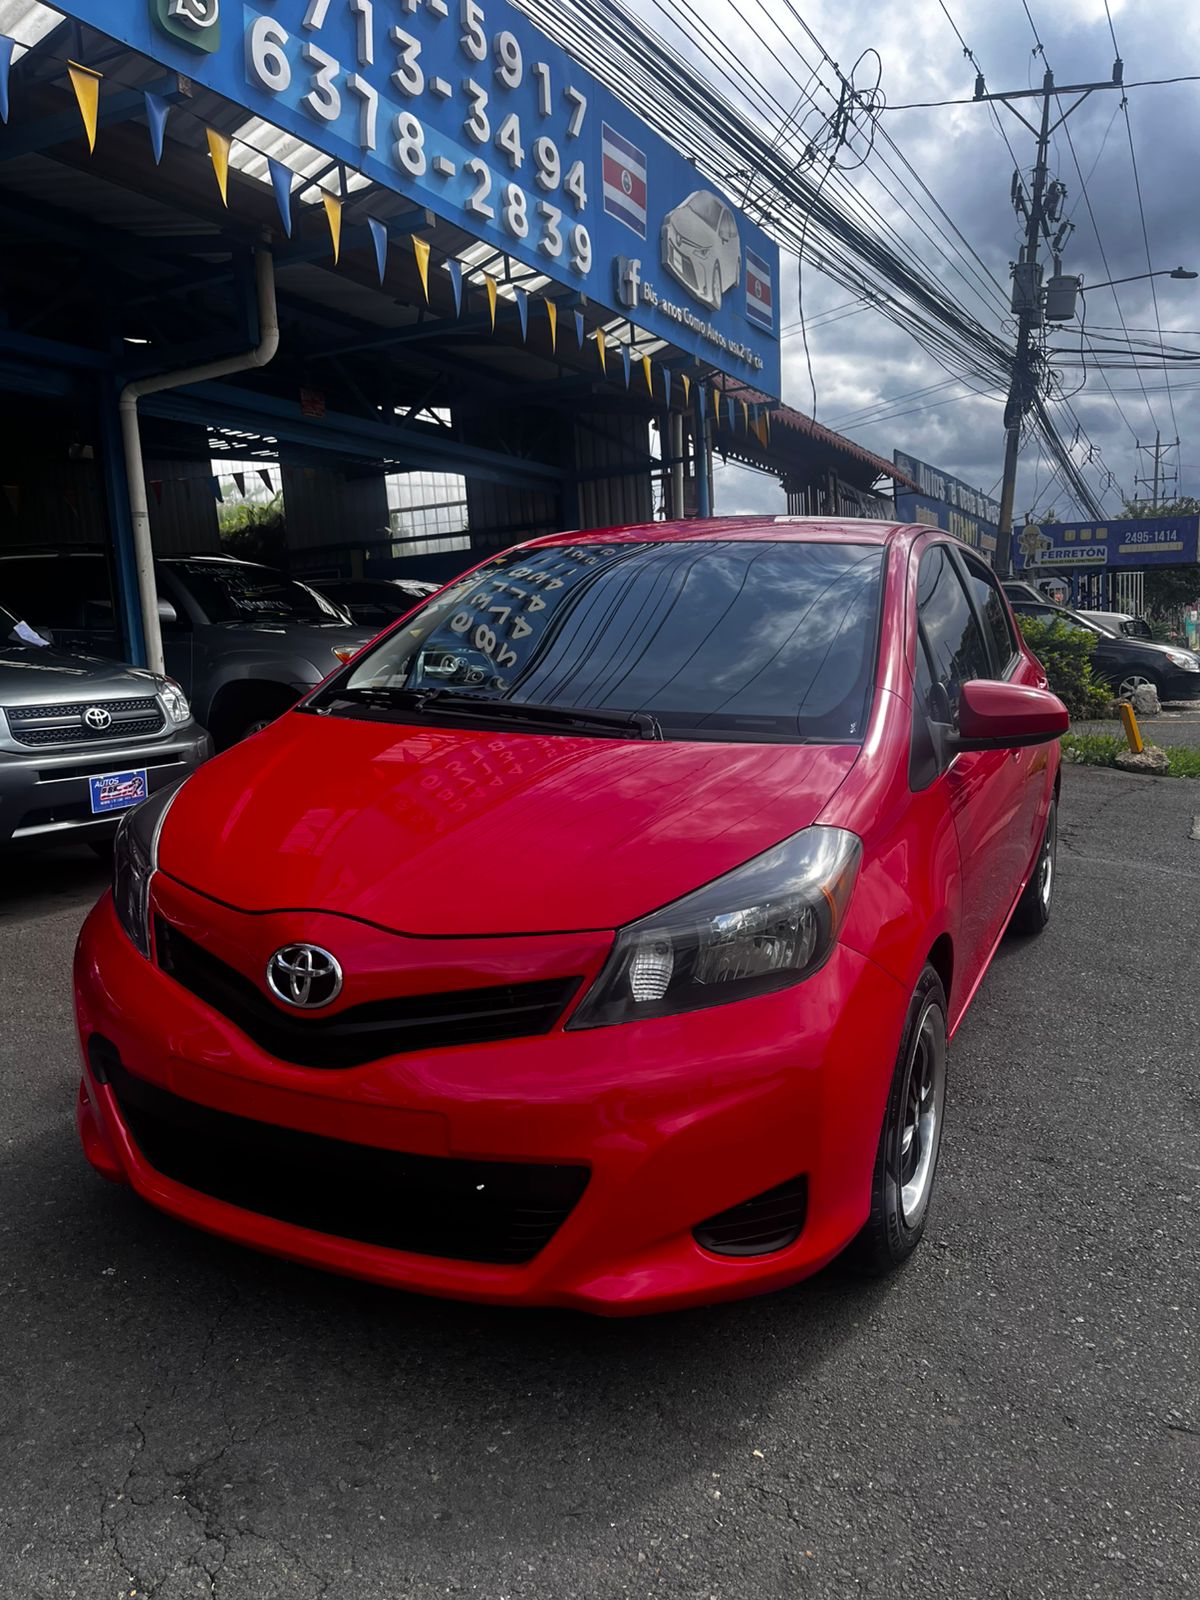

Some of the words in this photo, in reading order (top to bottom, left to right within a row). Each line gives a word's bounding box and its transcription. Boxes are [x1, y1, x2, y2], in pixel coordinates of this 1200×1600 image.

[250, 15, 592, 275] 6378-2839
[1125, 529, 1177, 543] 2495-1414
[1040, 546, 1106, 560] FERRETÓN
[94, 776, 120, 789] AUTOS
